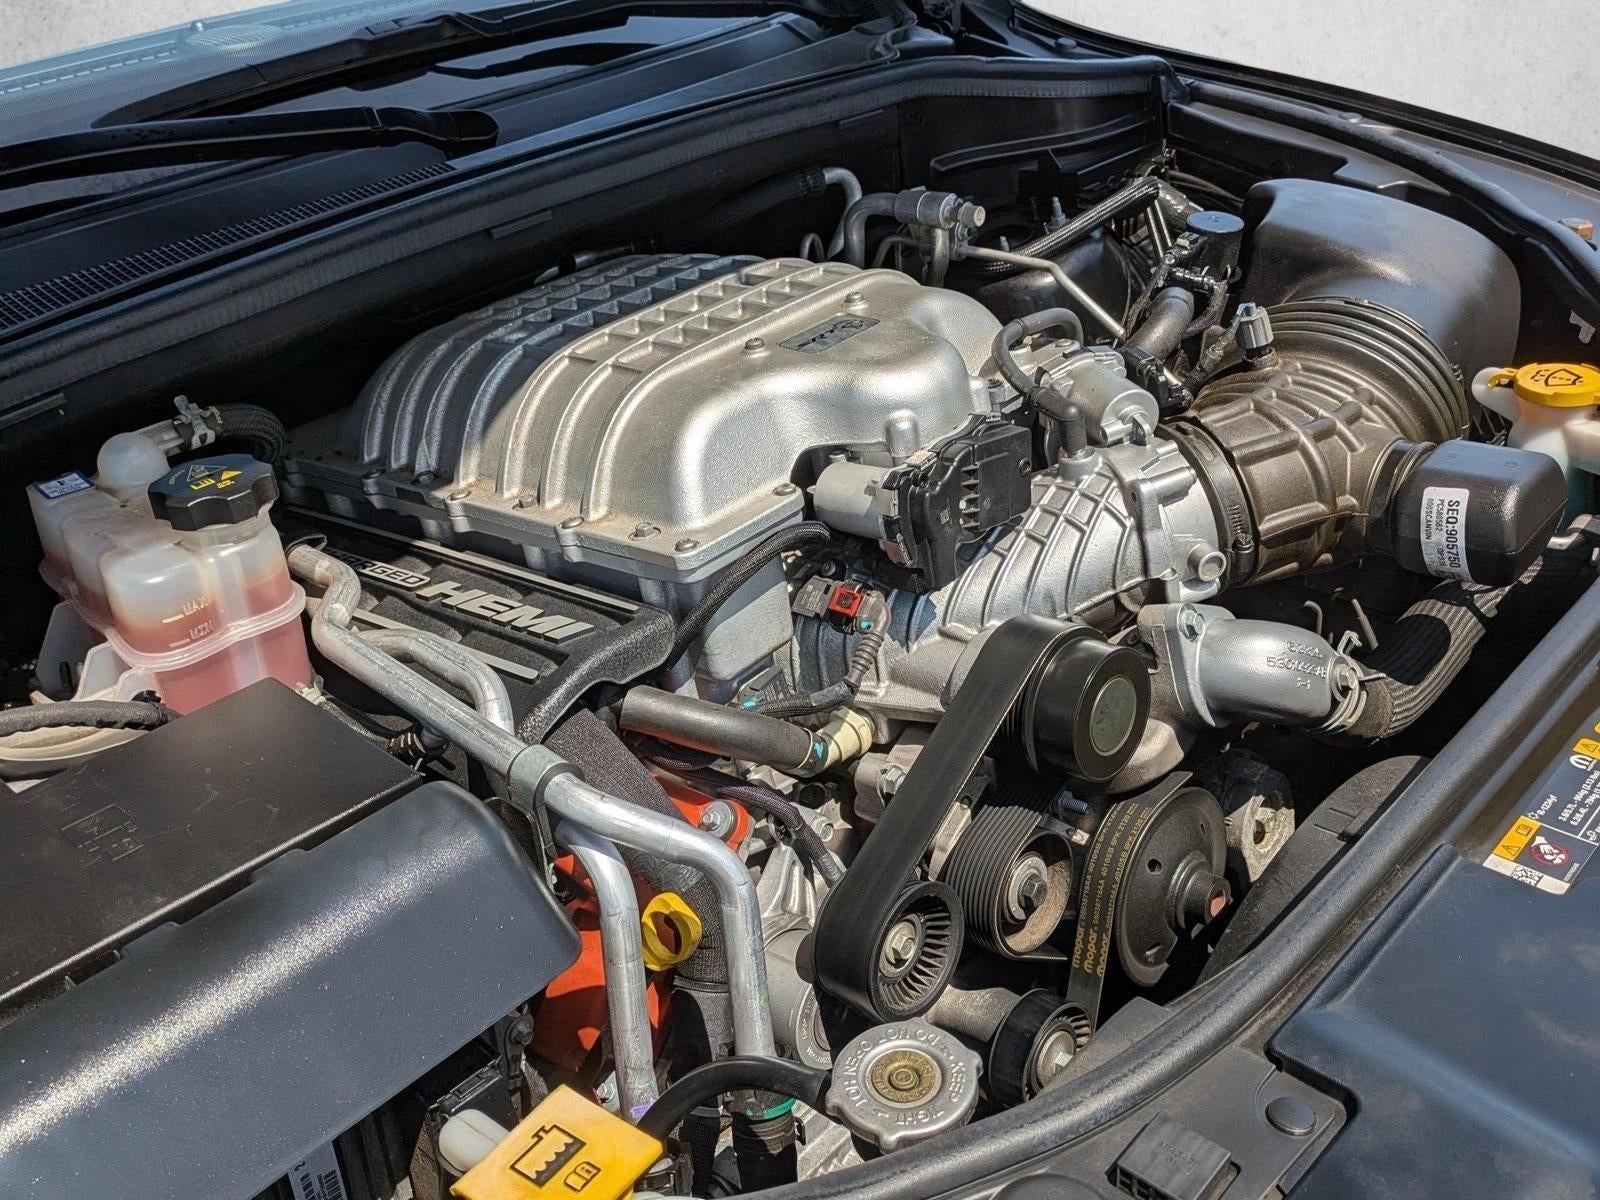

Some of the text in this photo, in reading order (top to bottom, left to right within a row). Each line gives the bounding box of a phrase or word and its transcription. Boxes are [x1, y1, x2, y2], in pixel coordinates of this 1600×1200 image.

[1445, 500, 1461, 568] SEQ:905750
[415, 580, 595, 645] HEMI
[1131, 818, 1143, 835] 2120
[1083, 928, 1097, 973] mopar
[1111, 830, 1121, 846] 6PK
[1119, 814, 1131, 831] 2120
[1072, 927, 1085, 969] mopar
